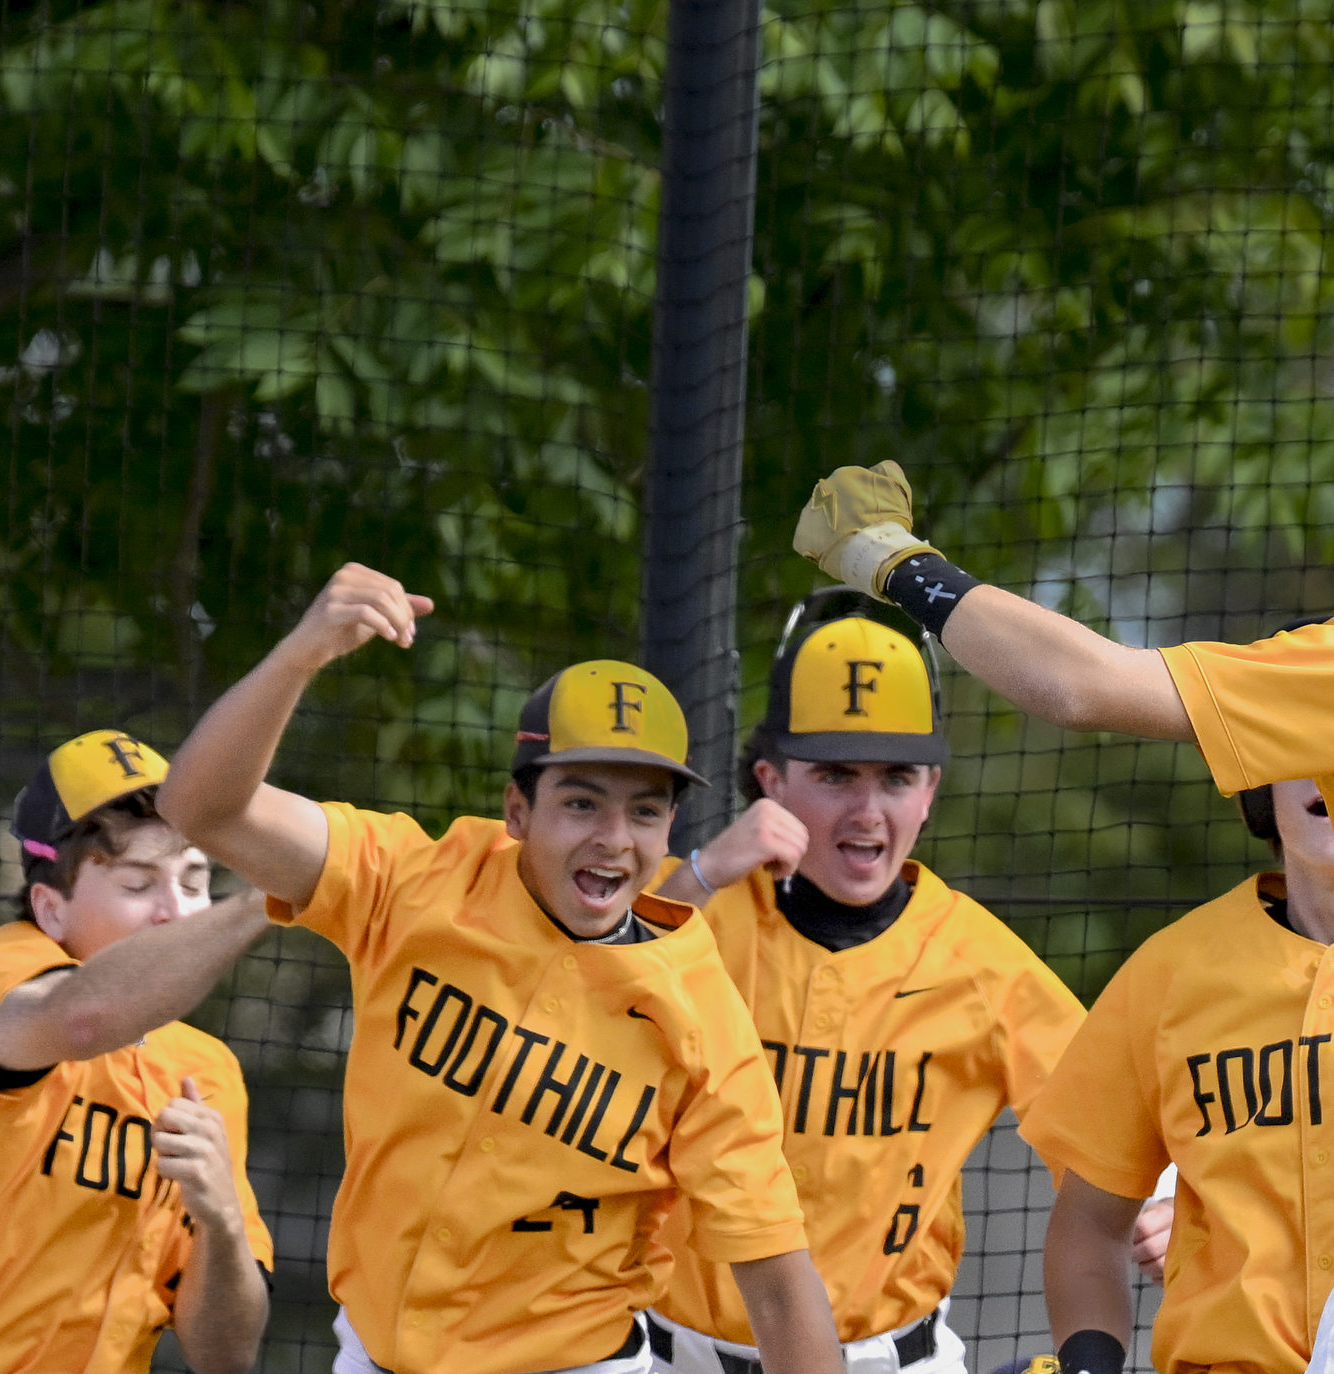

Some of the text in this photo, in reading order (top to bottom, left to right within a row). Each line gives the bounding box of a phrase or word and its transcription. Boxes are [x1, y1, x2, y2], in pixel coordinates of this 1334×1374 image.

[608, 682, 646, 735] F
[842, 660, 884, 718] F
[101, 738, 146, 779] F
[393, 966, 657, 1173] FOOTHILL
